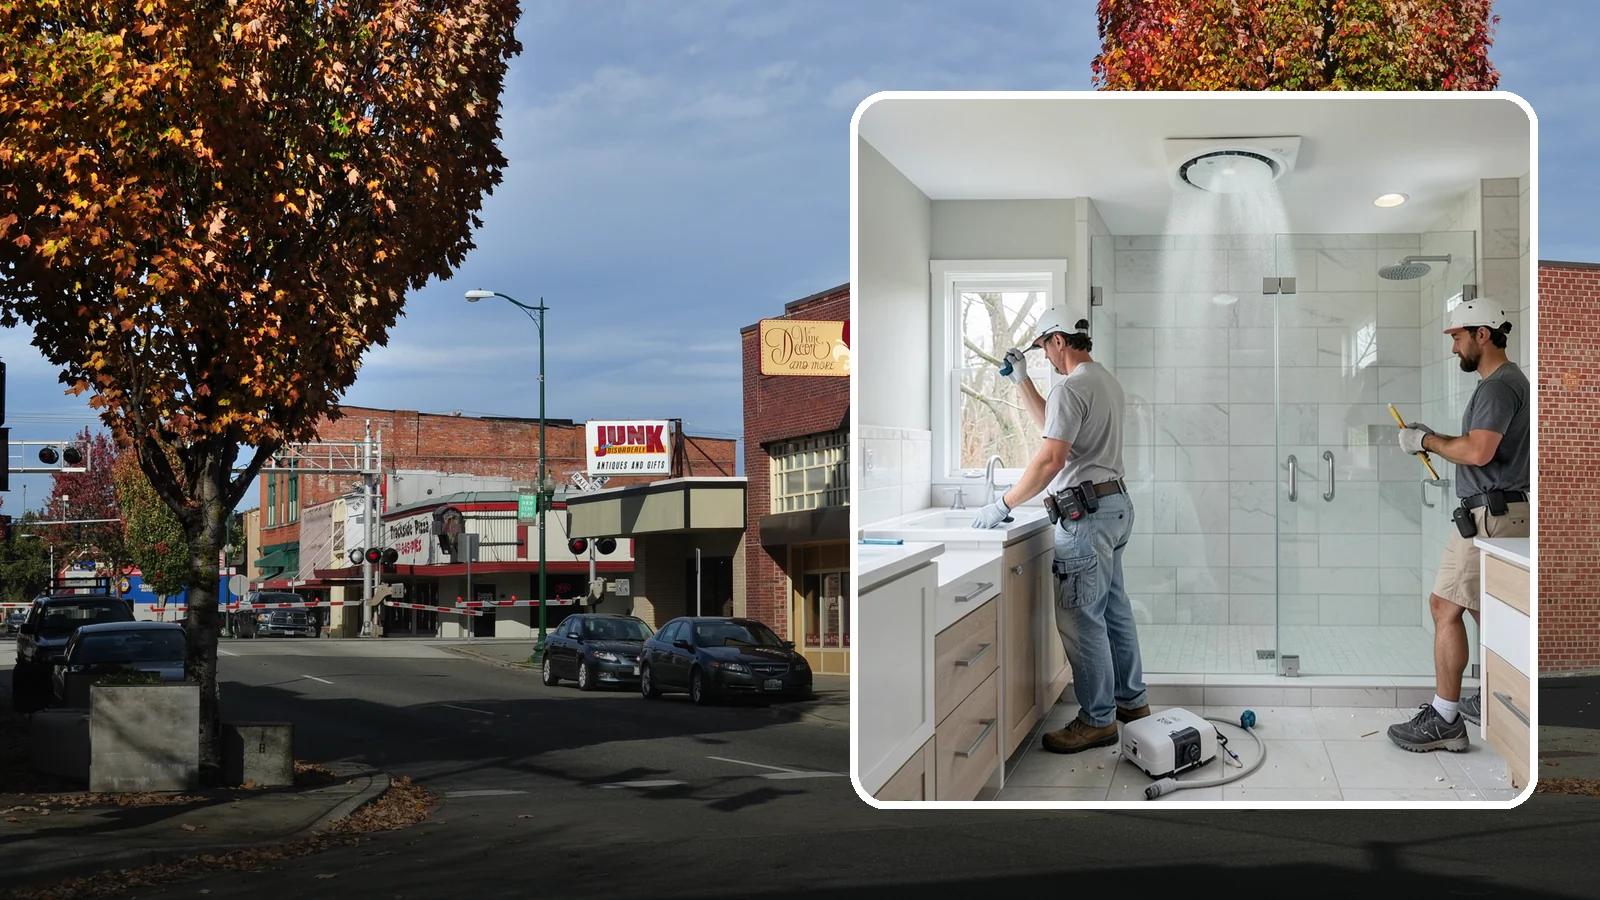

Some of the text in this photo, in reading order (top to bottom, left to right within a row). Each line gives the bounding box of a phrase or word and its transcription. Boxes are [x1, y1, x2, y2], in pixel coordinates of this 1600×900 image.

[765, 327, 830, 365] Decor
[595, 425, 665, 457] JUNK
[607, 446, 646, 454] DISORDERLY
[596, 460, 665, 470] ANTIQUES AND GIFTS
[414, 519, 429, 535] Pizza
